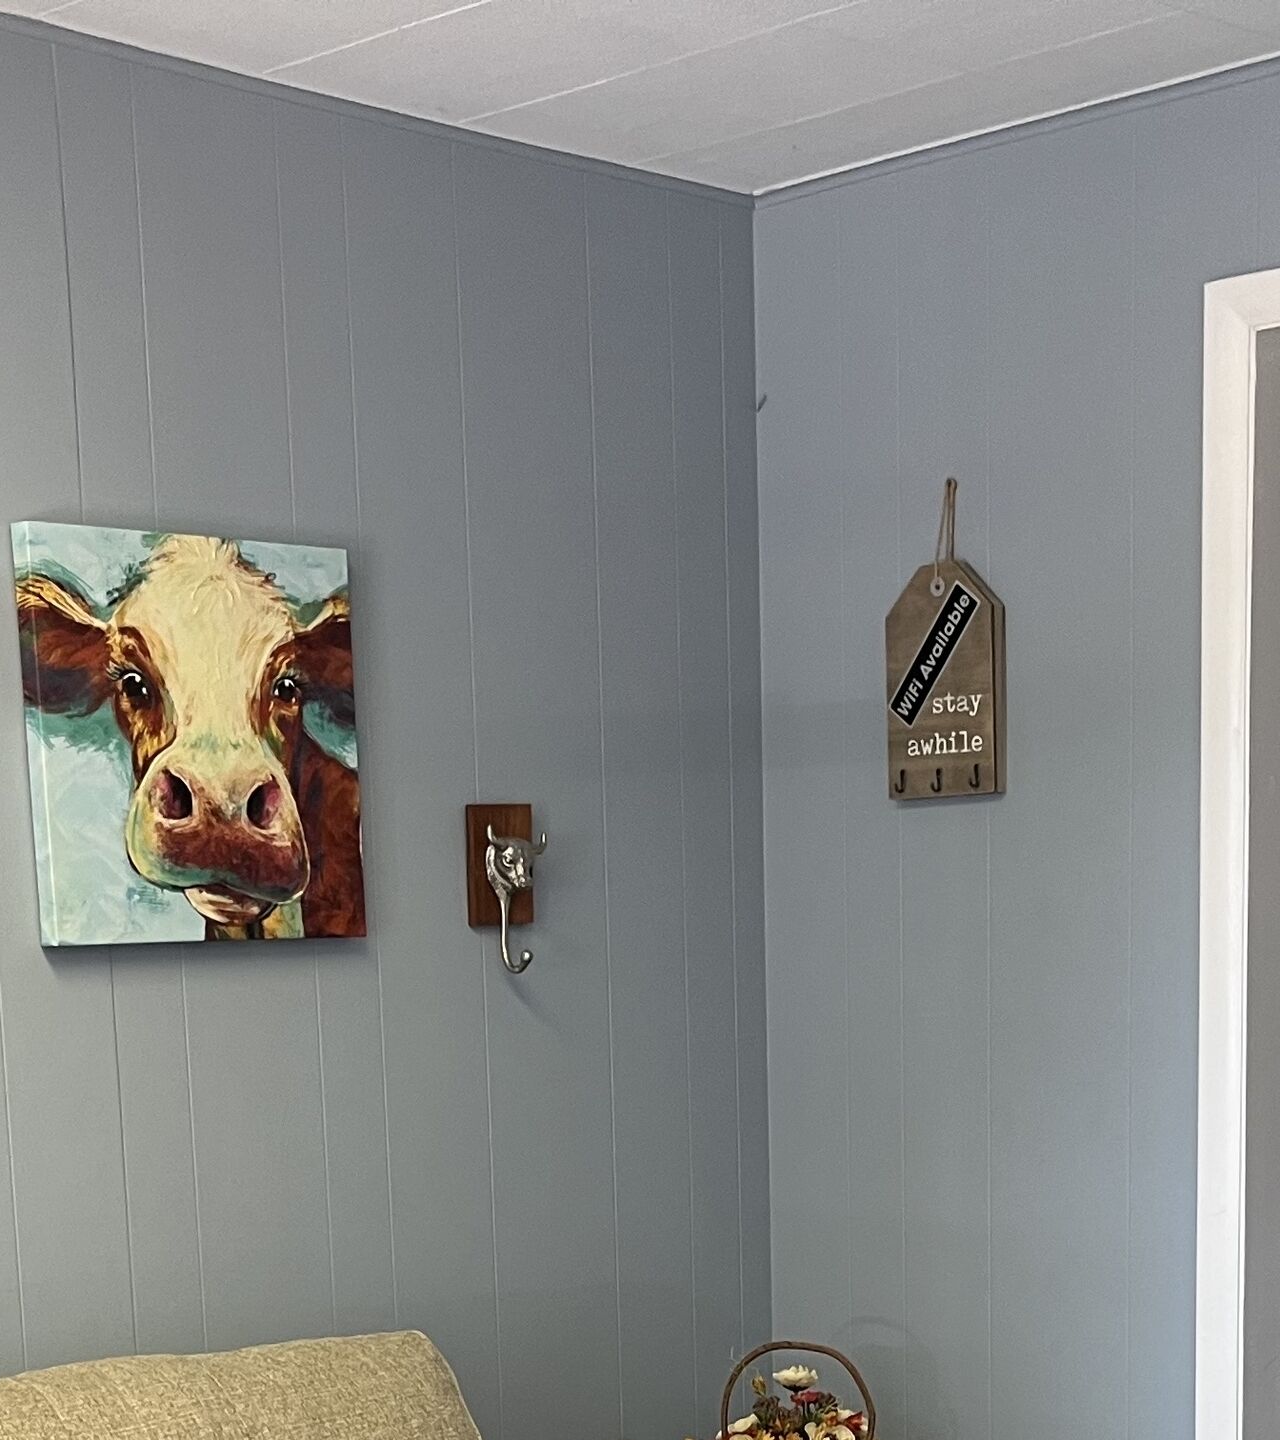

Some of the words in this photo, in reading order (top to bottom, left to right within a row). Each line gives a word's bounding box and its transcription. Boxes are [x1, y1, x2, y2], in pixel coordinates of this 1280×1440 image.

[897, 678, 923, 716] WiFi
[920, 594, 970, 680] Available
[932, 692, 982, 716] stay
[907, 731, 983, 756] awhile
